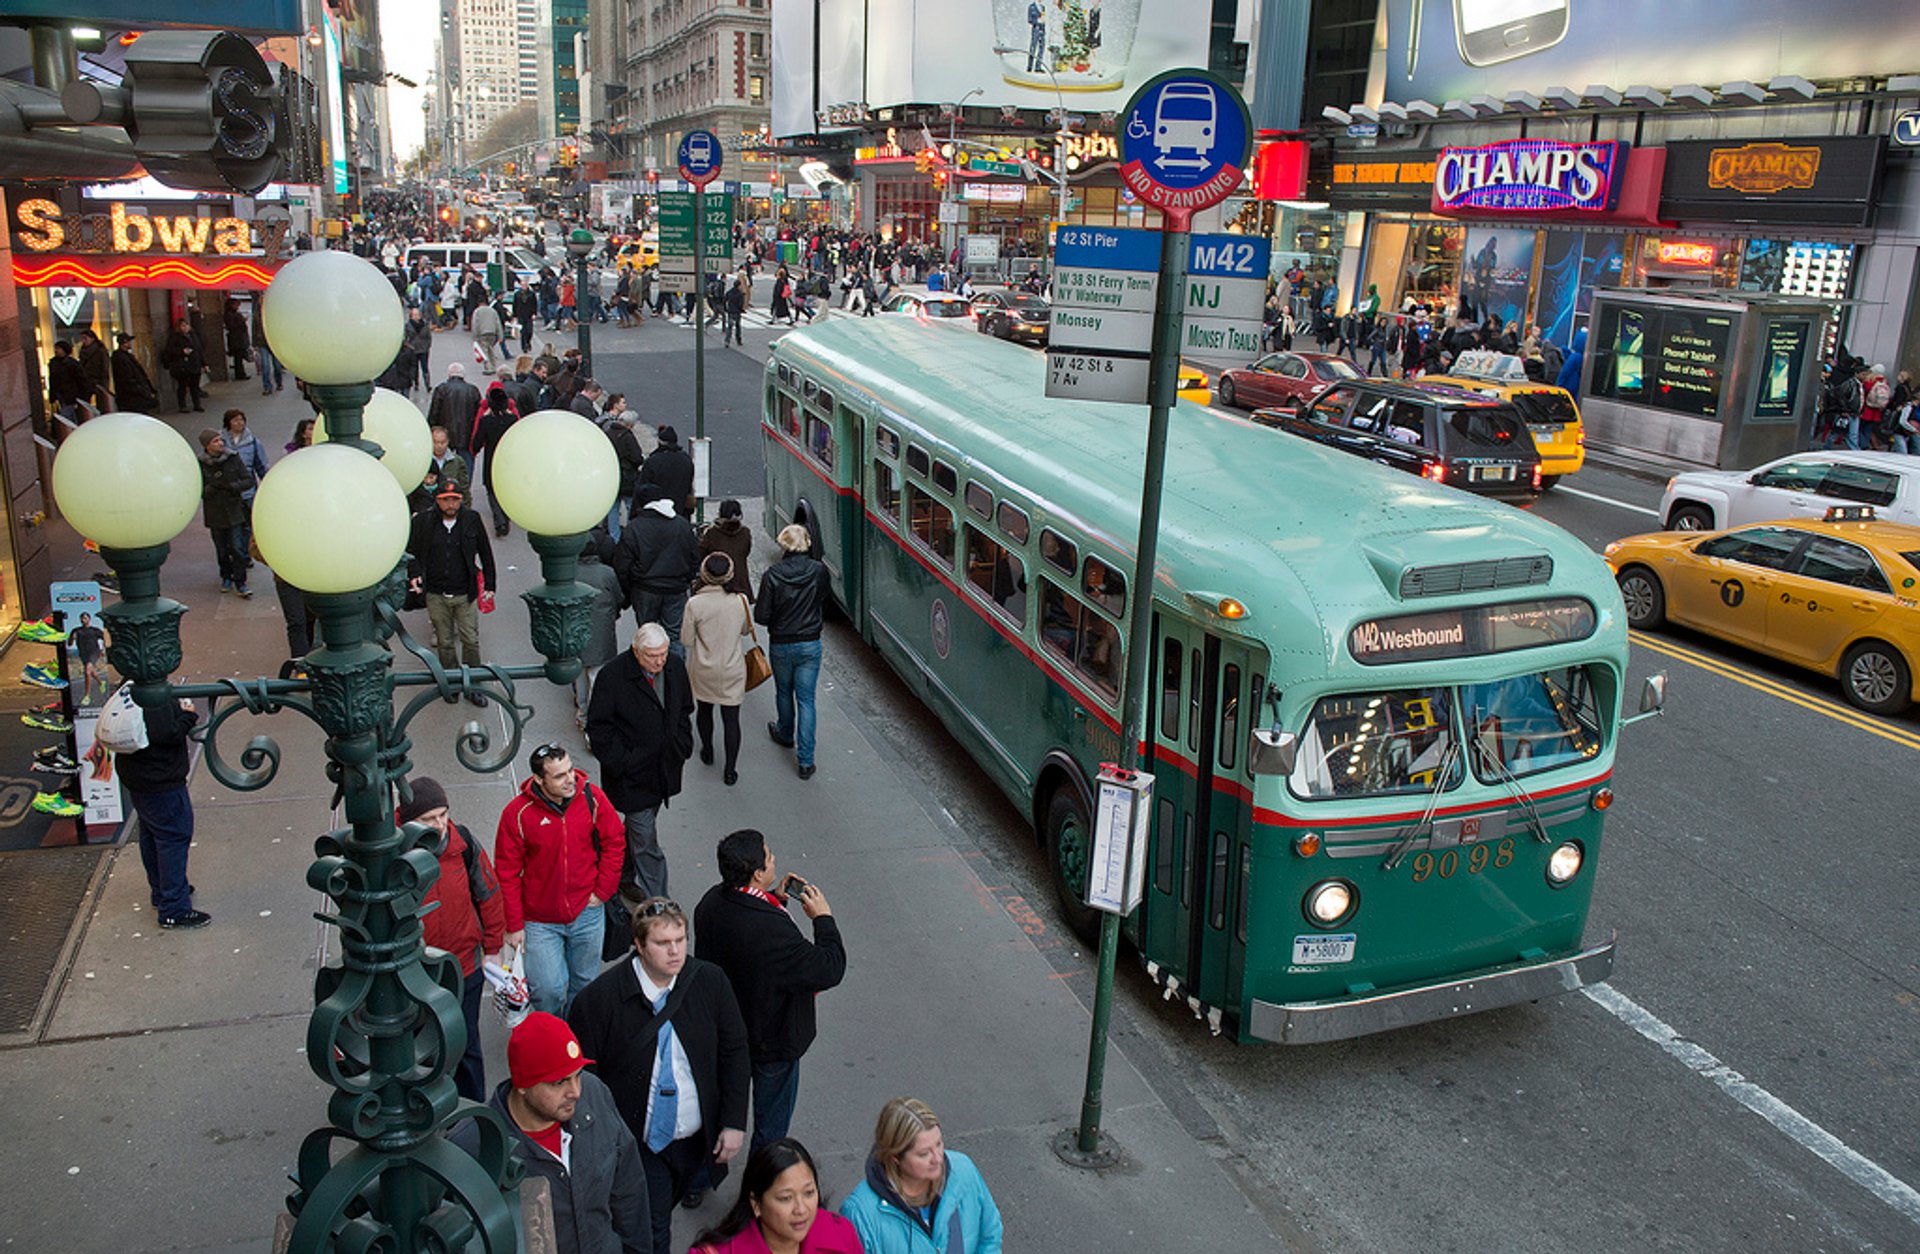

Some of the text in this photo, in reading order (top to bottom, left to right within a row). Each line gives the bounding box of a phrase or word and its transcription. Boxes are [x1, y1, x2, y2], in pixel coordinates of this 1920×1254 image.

[1436, 149, 1600, 201] CHAMPS
[1713, 153, 1813, 181] CHAMPS
[1129, 169, 1233, 207] NO STANDING
[706, 195, 724, 208] x17
[707, 212, 727, 225] x22
[709, 228, 729, 240] x30
[1062, 232, 1119, 247] 42 St Pier
[707, 244, 725, 256] x31
[1194, 242, 1255, 273] M42
[706, 260, 720, 271] NJ
[1059, 272, 1068, 284] W
[1071, 273, 1083, 285] 38
[1086, 274, 1098, 286] St
[1100, 275, 1124, 291] Ferry
[1058, 289, 1123, 306] NY Waterway
[1190, 283, 1221, 309] NJ
[1056, 313, 1102, 331] Monsey
[1188, 324, 1258, 351] MONSEY TRAILS
[1054, 357, 1113, 372] W 42 St &
[1053, 372, 1079, 386] 7 Av
[1726, 583, 1740, 604] T
[1354, 622, 1463, 652] M42 Westbound
